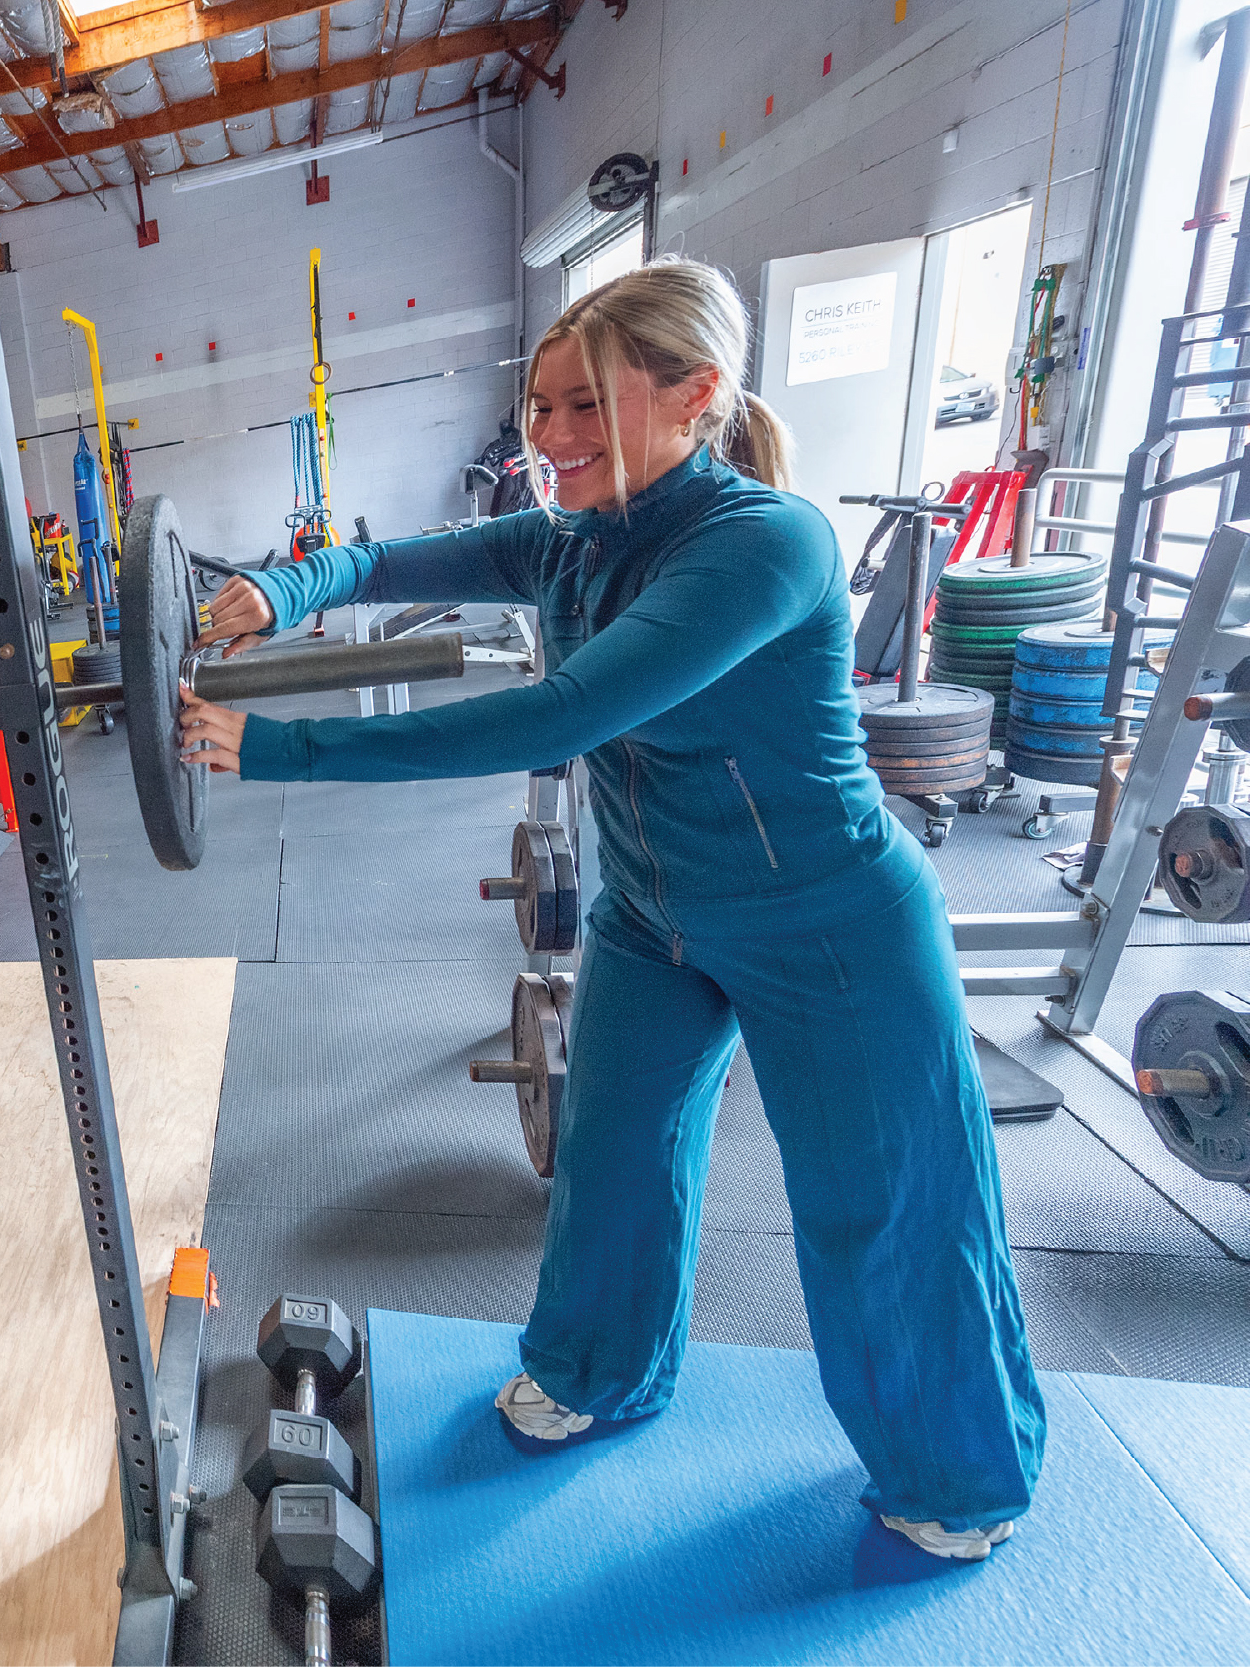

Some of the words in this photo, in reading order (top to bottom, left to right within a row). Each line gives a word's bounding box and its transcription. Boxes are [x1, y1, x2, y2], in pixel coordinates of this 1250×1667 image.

[805, 304, 843, 322] CHRIS
[846, 299, 881, 315] KEITH
[803, 326, 843, 339] PERSONAL
[845, 320, 881, 330] TRANNG
[799, 348, 827, 364] 5260
[29, 617, 80, 882] ROGUE
[280, 1424, 314, 1447] 60
